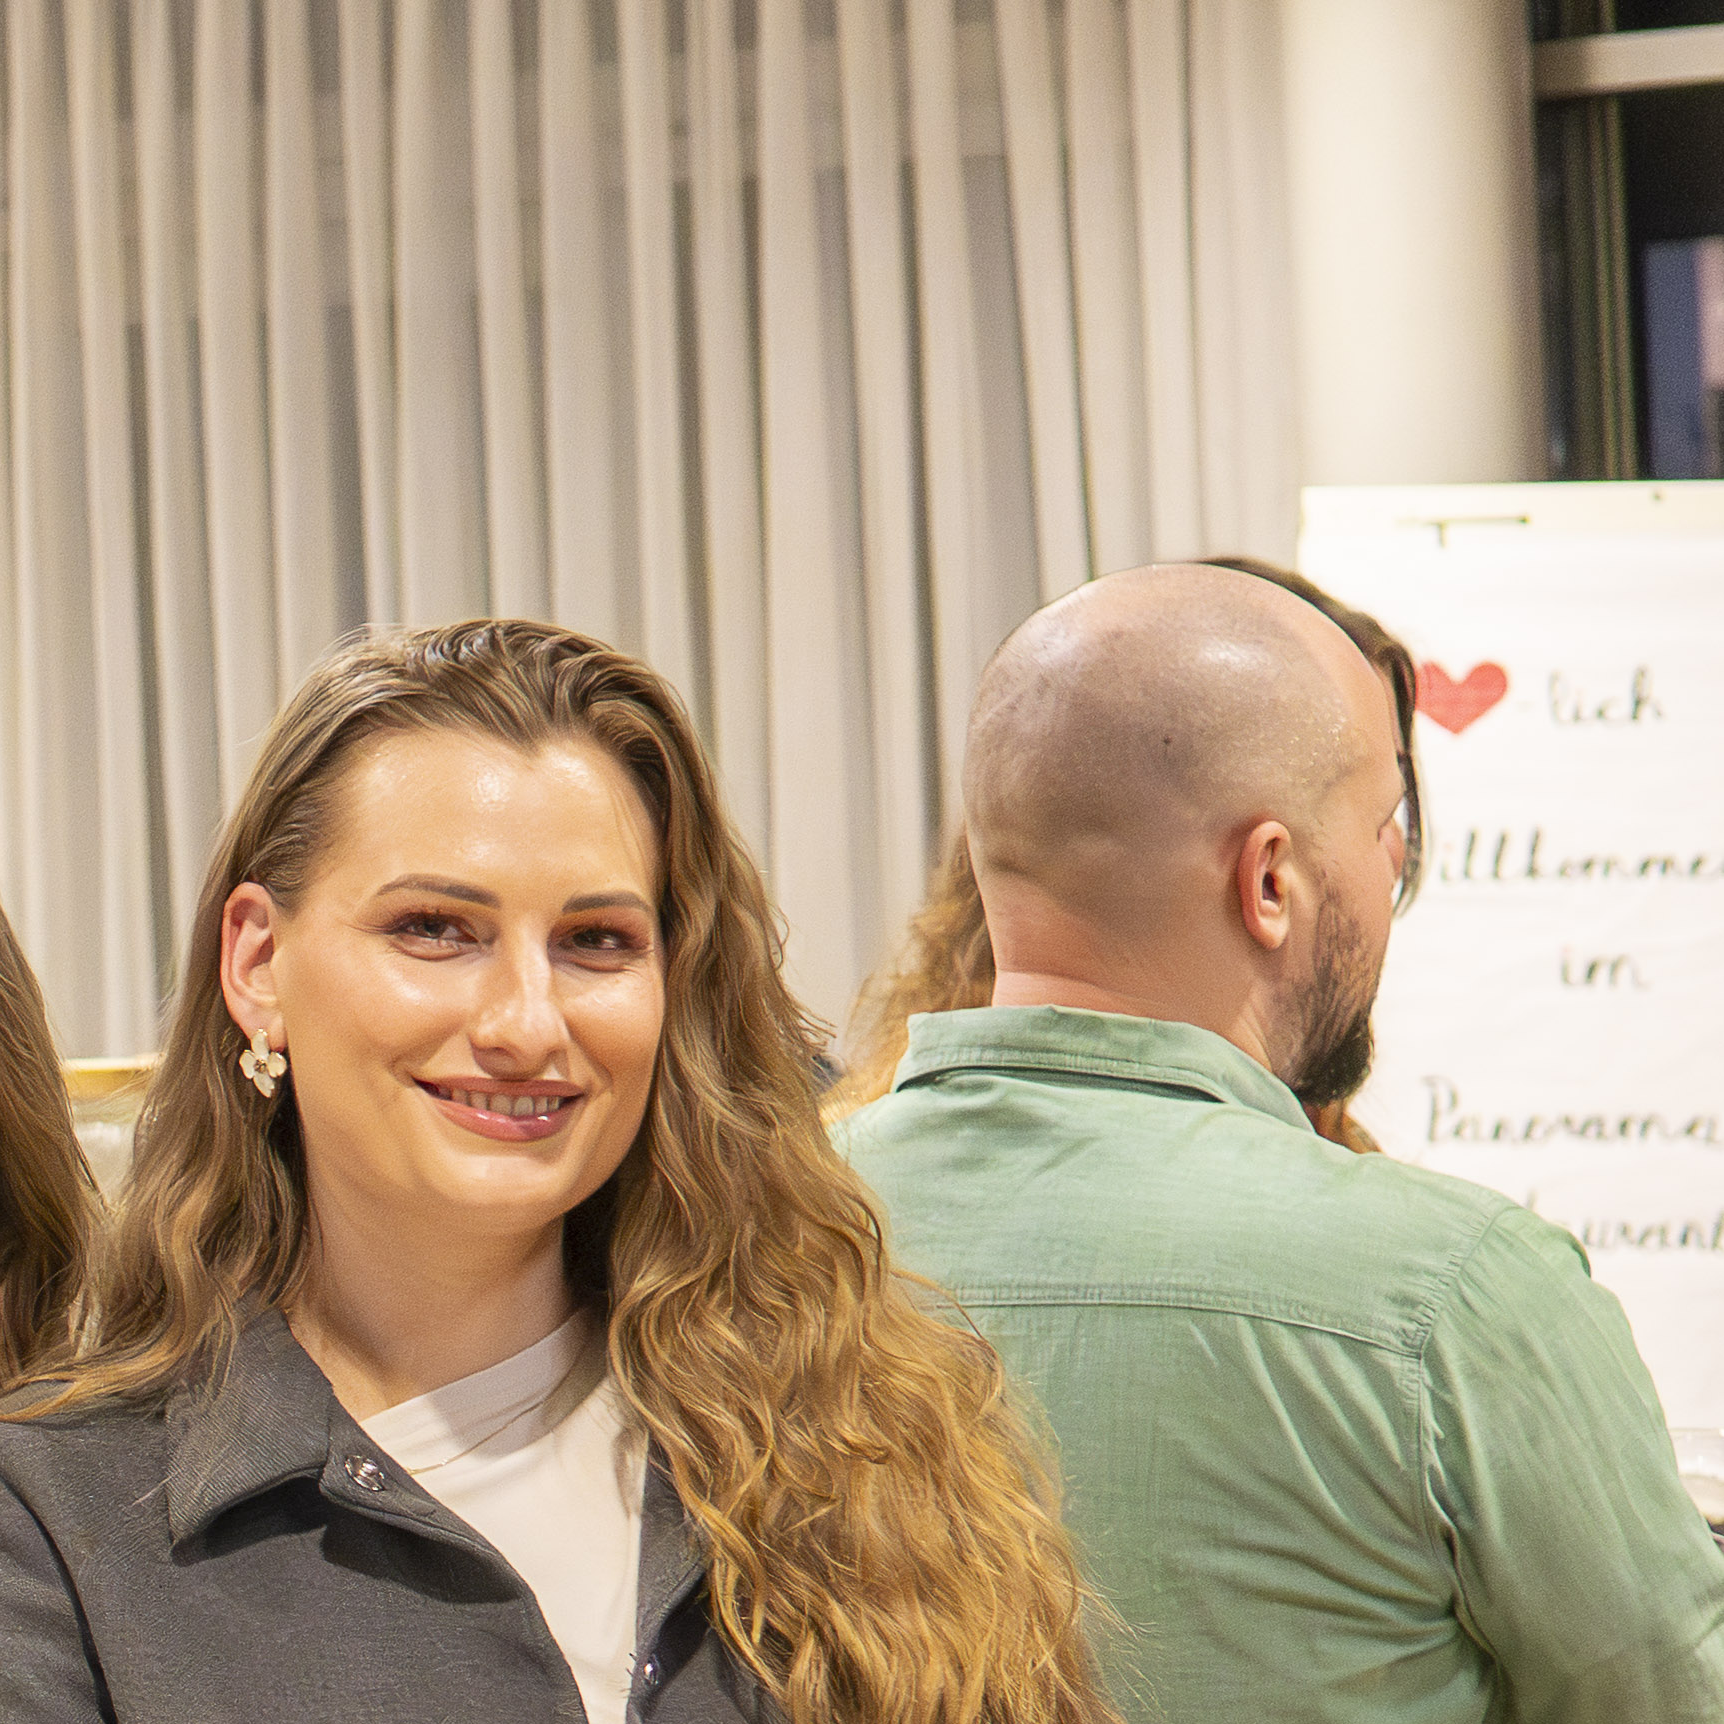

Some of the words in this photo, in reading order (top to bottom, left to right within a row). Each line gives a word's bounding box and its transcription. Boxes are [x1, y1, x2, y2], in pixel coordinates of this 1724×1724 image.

[1439, 826, 1724, 883] illkomme
[1560, 945, 1650, 989] im
[1421, 1074, 1724, 1144] Panorama
